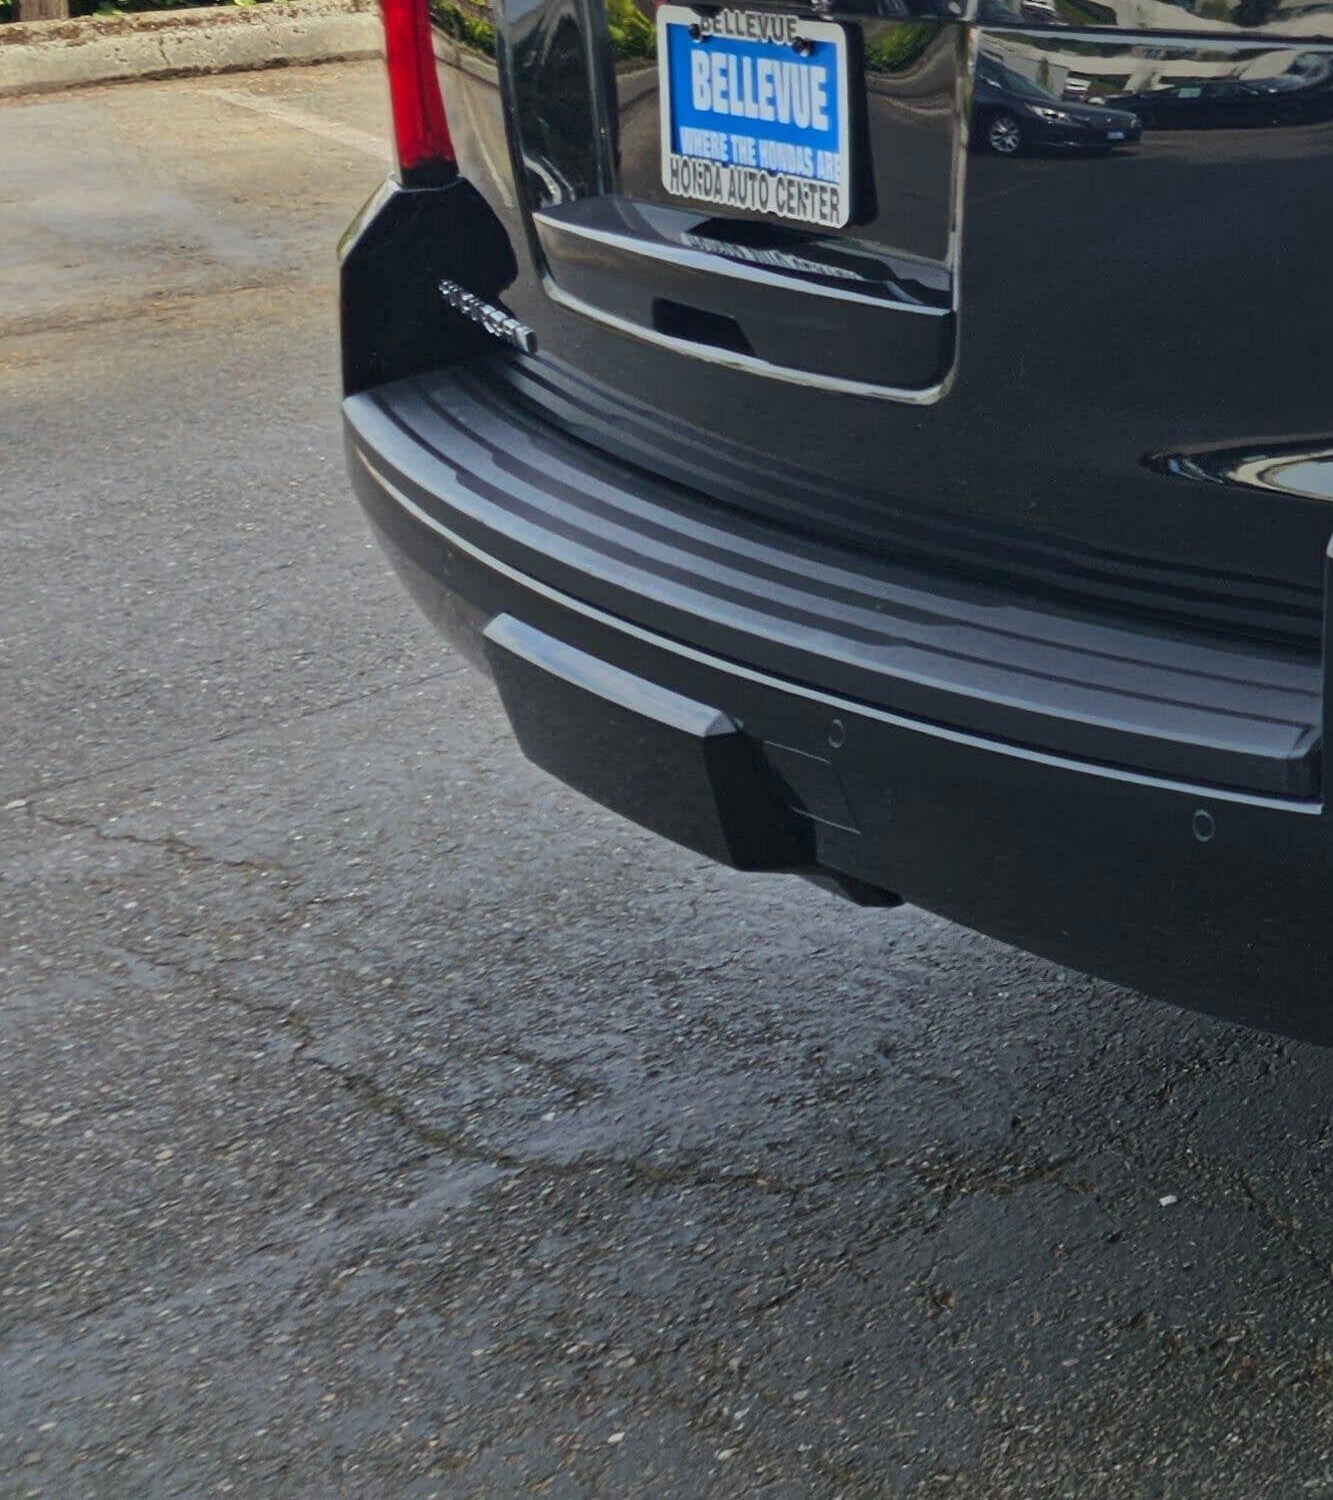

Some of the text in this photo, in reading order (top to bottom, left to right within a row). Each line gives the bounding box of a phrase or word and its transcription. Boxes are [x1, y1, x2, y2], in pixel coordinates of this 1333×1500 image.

[700, 10, 798, 44] BELLEVUE
[690, 50, 829, 131] BELLEVUE
[679, 127, 728, 161] WHERE
[730, 134, 756, 167] THE
[759, 140, 813, 177] HONDAS
[670, 158, 840, 224] HONDA AUTO CENTER
